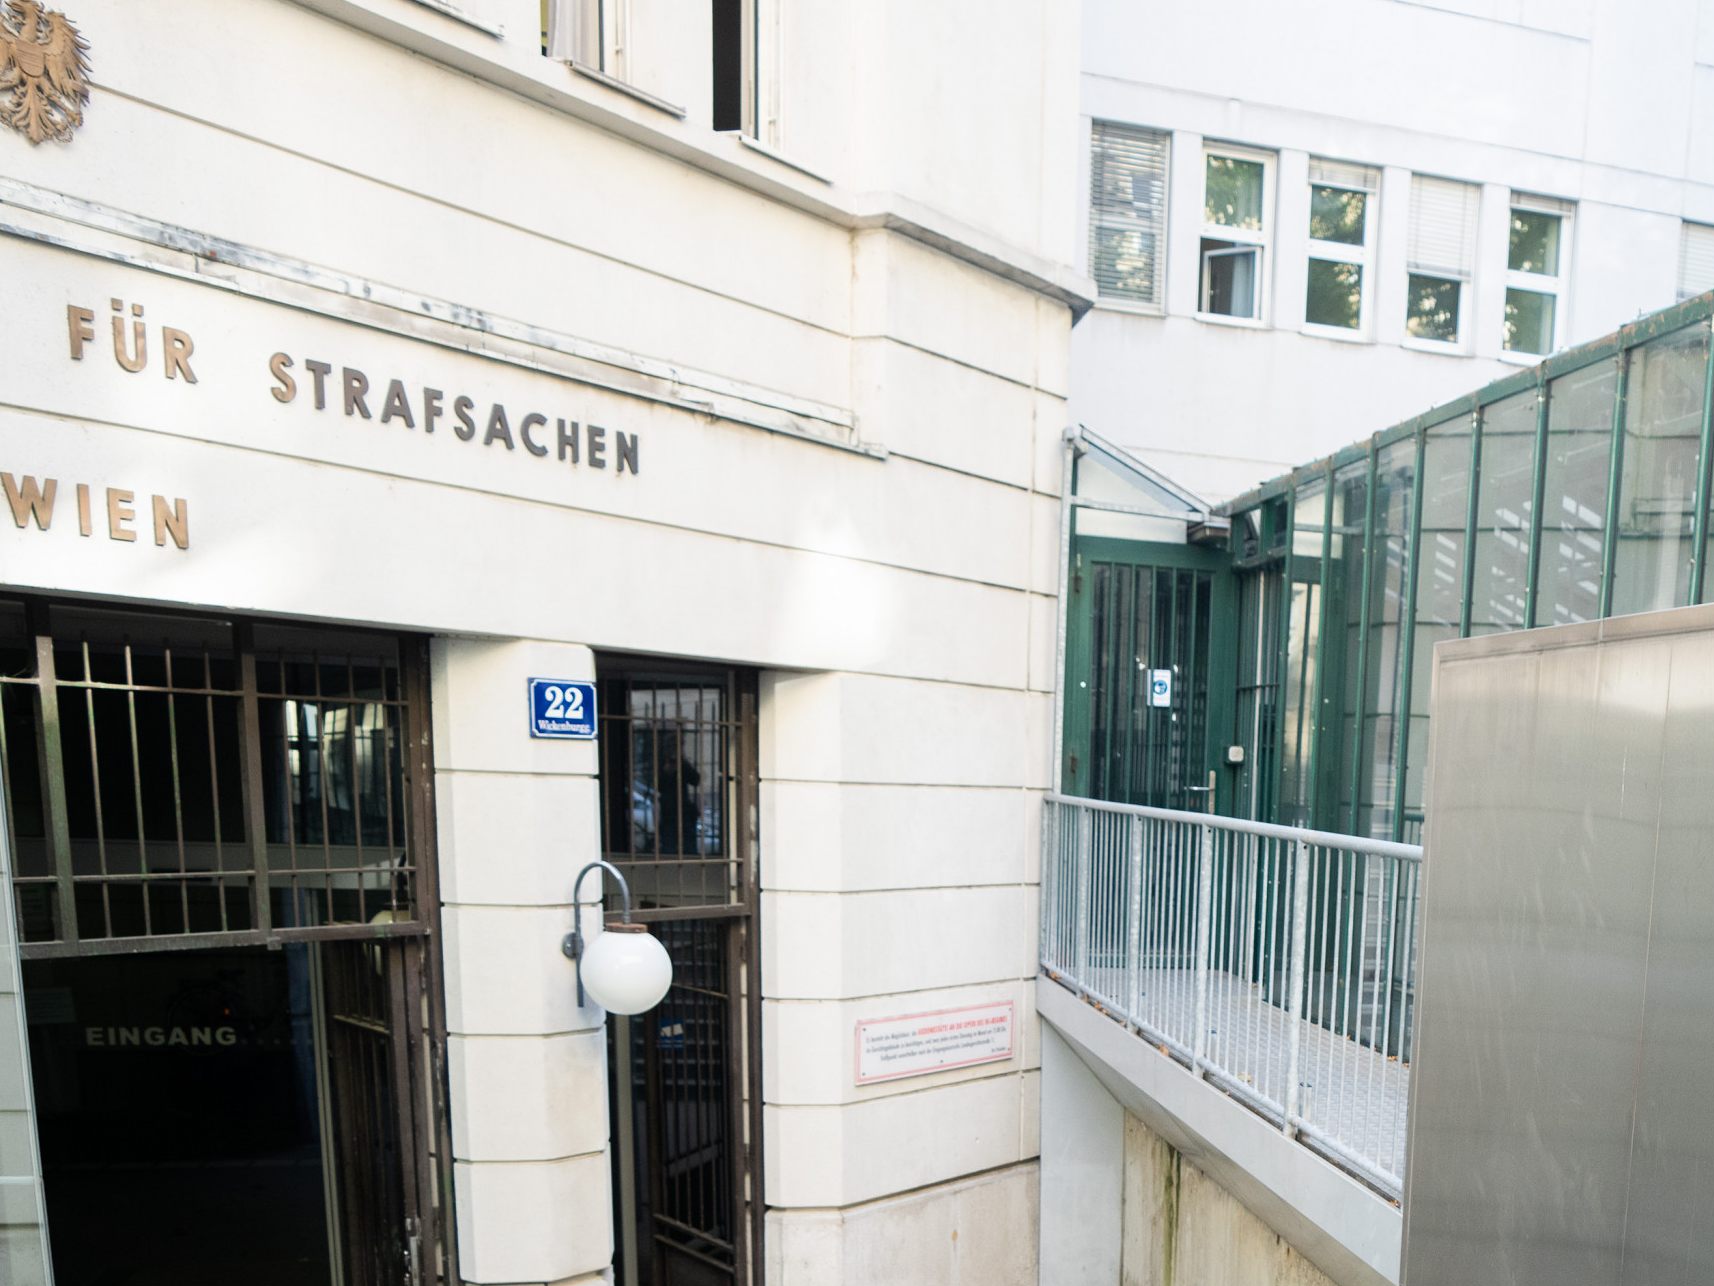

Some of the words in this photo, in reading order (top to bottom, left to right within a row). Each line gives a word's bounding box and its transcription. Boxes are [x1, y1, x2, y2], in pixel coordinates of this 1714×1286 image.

[67, 297, 199, 385] FÜR
[269, 351, 640, 475] STRAFSACHEN
[0, 471, 190, 550] WIEN
[544, 685, 584, 720] 22
[84, 1026, 238, 1046] EINGANG
